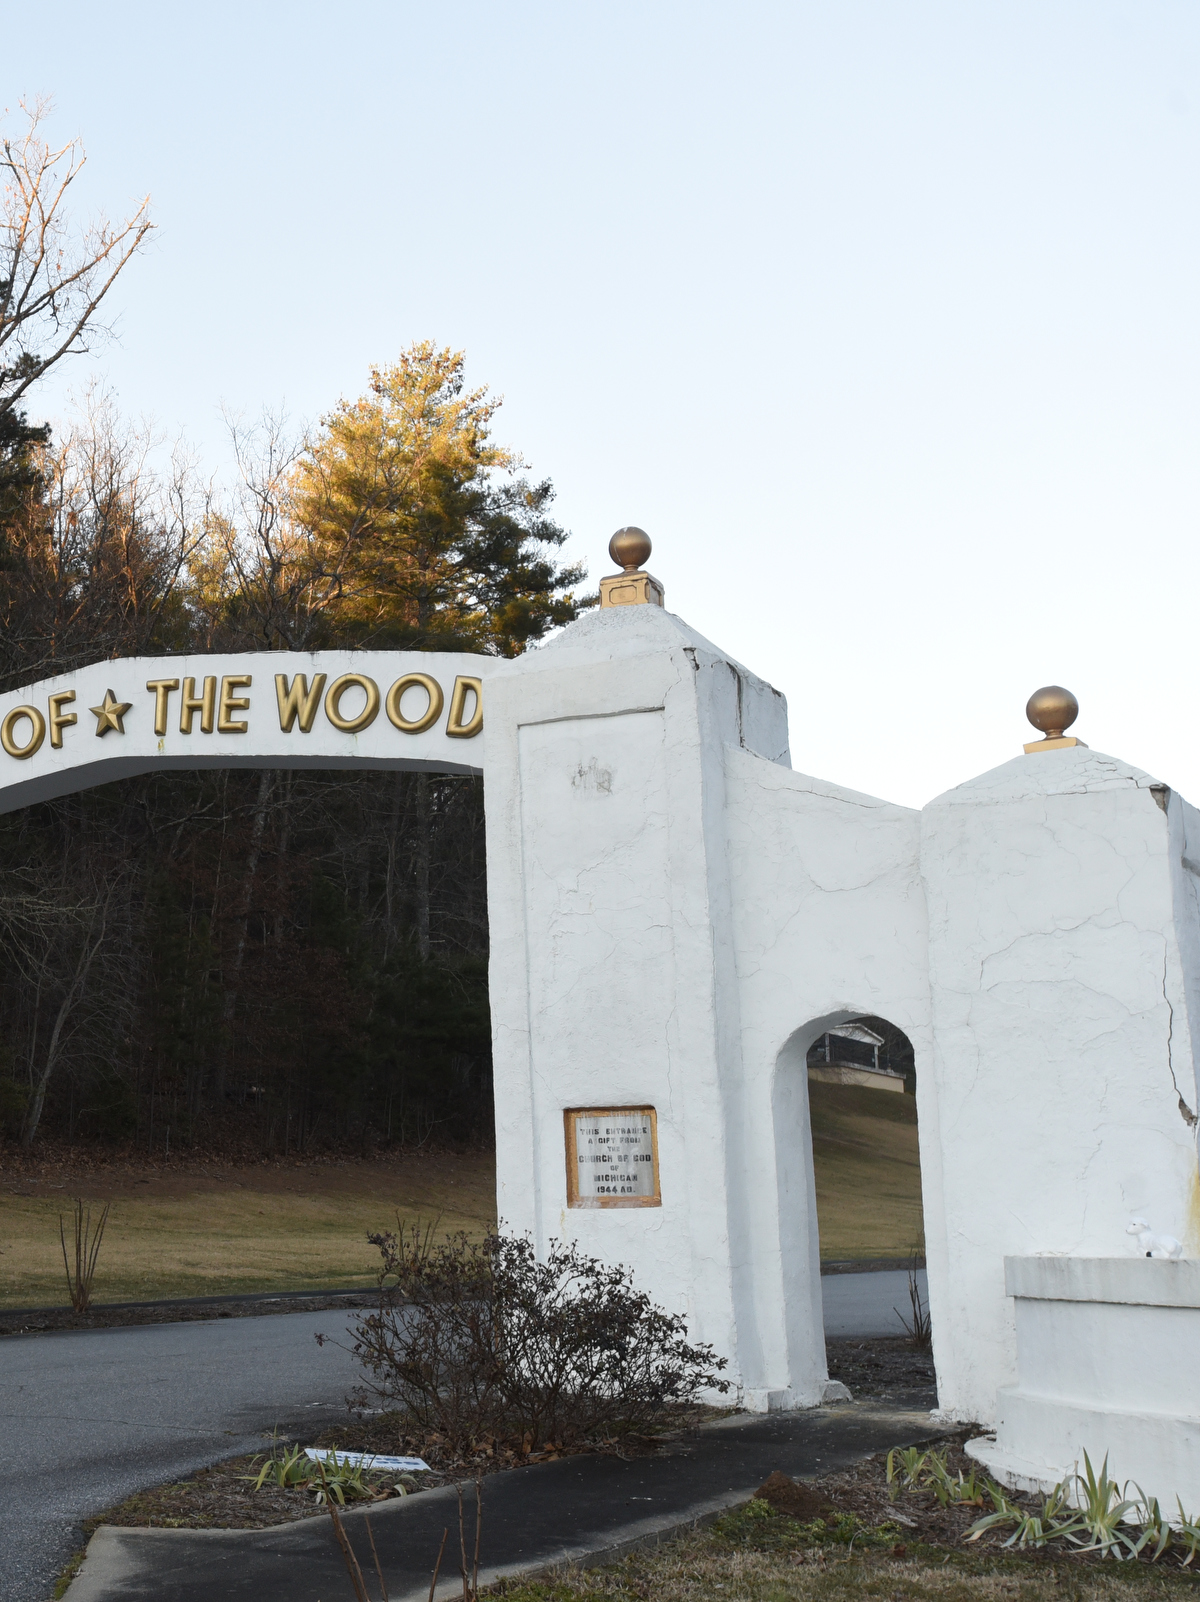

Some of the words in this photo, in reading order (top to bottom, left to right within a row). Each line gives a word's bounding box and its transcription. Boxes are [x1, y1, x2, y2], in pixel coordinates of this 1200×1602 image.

[0, 690, 78, 760] OF
[146, 674, 252, 736] THE
[578, 1154, 613, 1163] CHURCH
[617, 1154, 628, 1162] OF
[633, 1154, 651, 1162] GOD
[593, 1174, 638, 1182] MICHIGAN
[597, 1186, 618, 1194] 1944
